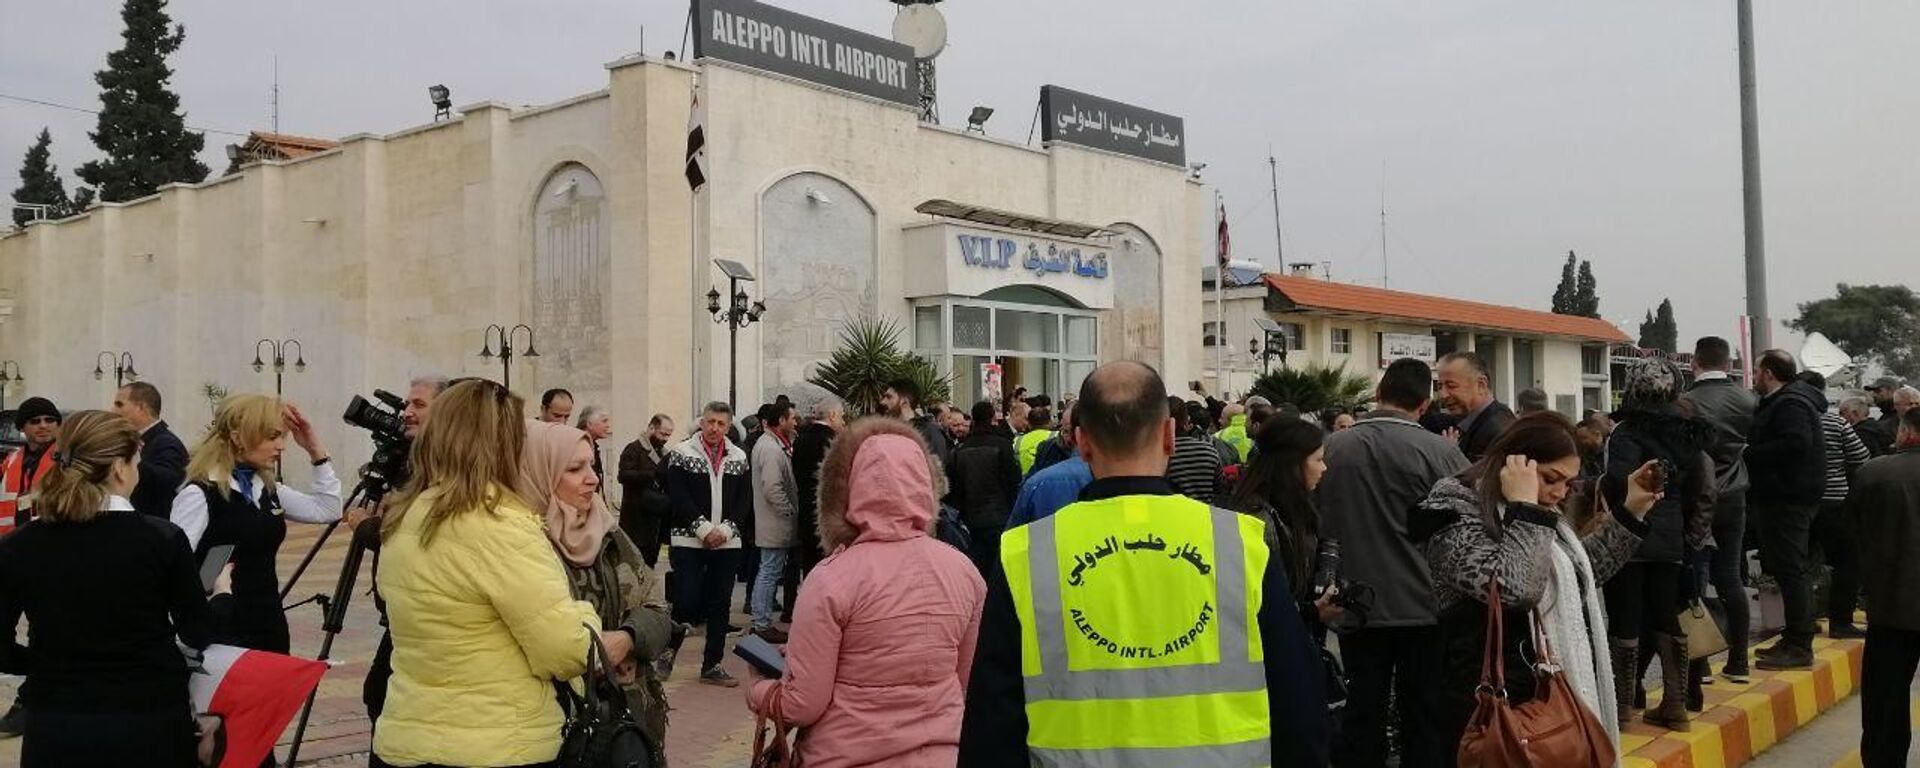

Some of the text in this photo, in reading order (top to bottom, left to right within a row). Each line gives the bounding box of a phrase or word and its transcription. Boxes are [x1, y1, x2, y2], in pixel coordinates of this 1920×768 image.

[712, 9, 907, 90] ALEPPO INTL AIRPORT
[1058, 103, 1180, 147] مطار حلب الدولي
[1067, 533, 1211, 586] مطار حلب الدولي
[1070, 608, 1118, 654] ALEPPO
